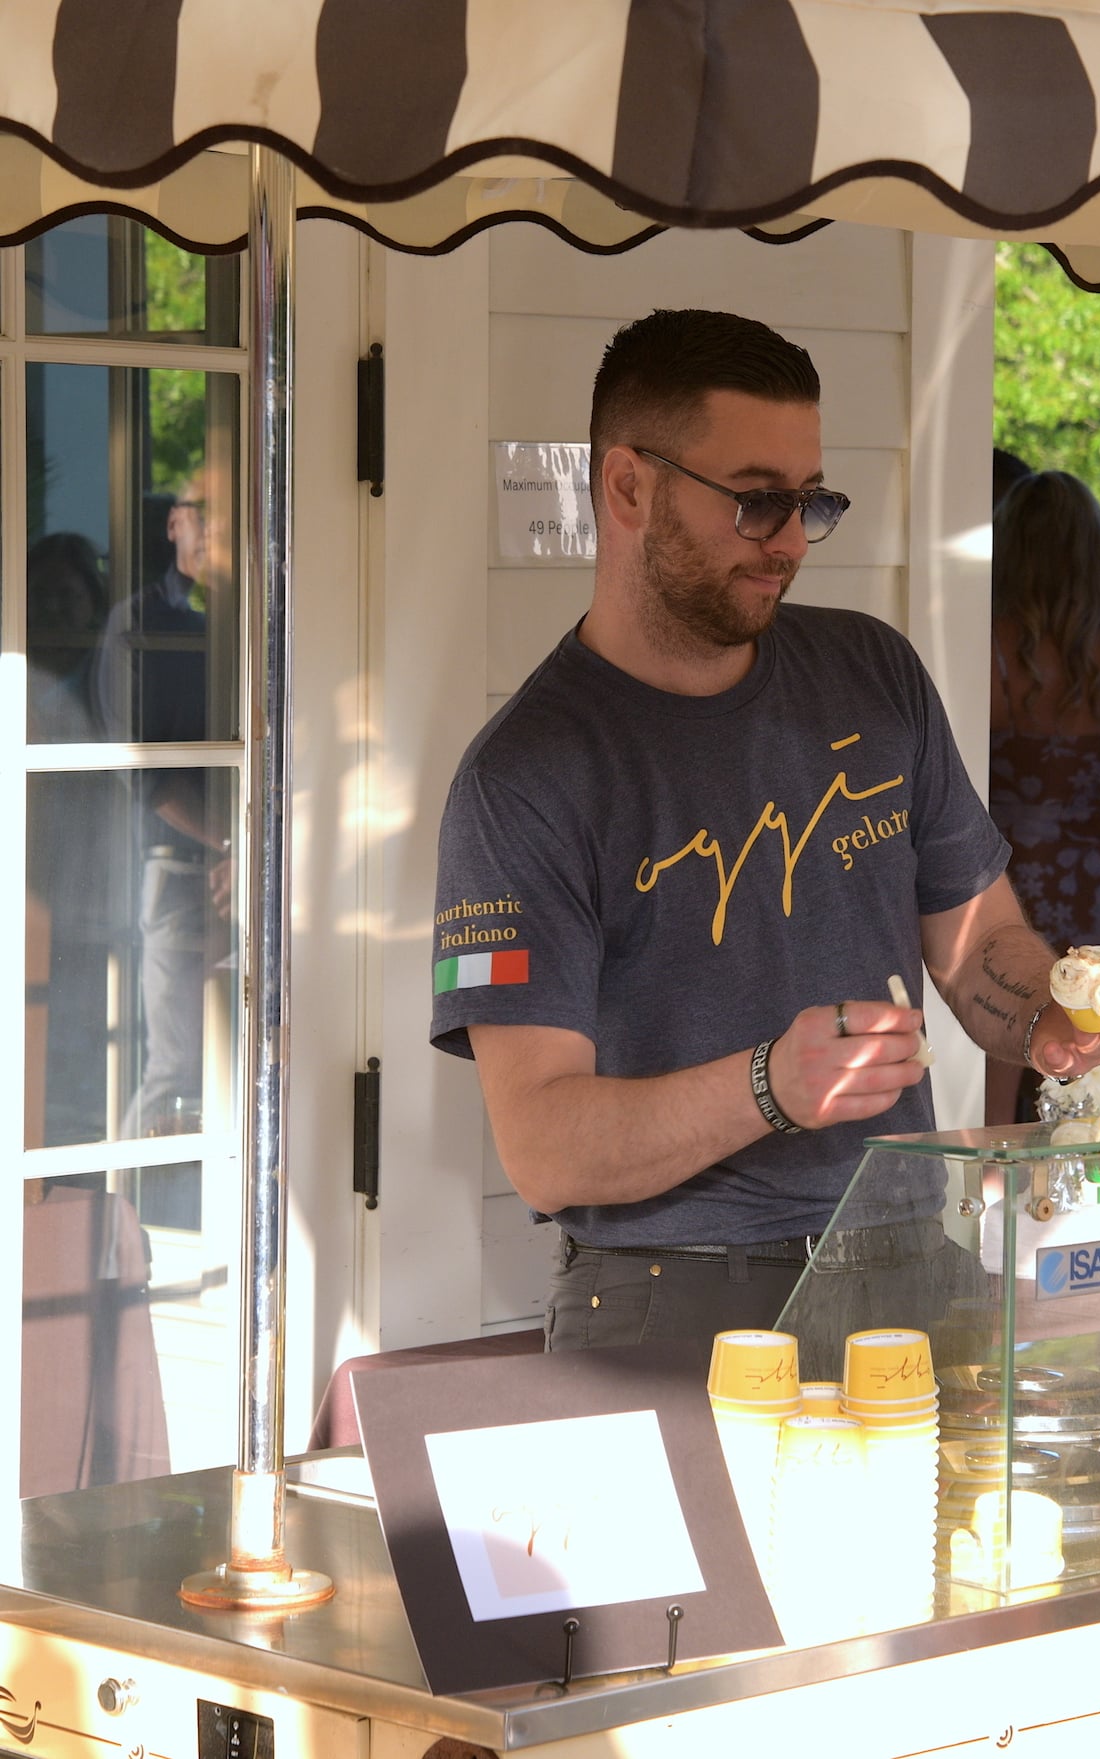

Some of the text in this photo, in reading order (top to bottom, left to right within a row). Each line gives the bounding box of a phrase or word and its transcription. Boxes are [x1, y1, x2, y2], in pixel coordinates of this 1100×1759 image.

[503, 479, 552, 491] Maximum
[529, 520, 589, 538] 49 Pele
[436, 893, 523, 925] authentic
[441, 924, 517, 949] italiano
